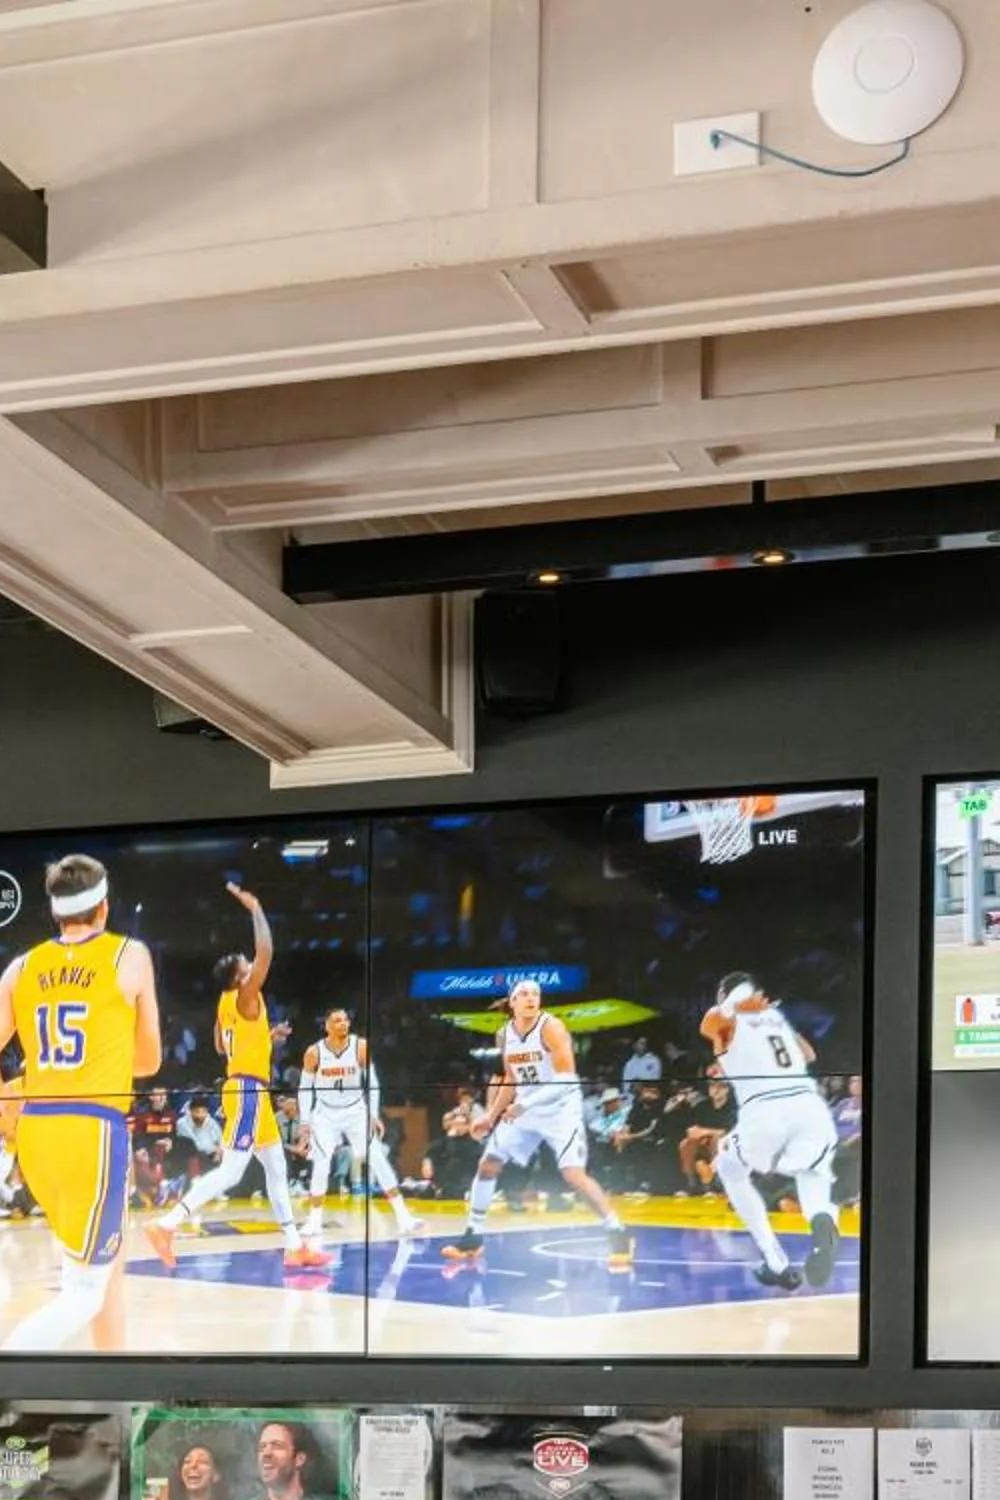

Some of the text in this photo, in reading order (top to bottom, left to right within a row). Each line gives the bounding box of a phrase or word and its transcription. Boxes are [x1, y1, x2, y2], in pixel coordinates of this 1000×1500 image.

[963, 799, 987, 811] TAB
[759, 829, 798, 846] LIVE
[35, 1003, 88, 1066] 15
[767, 1034, 793, 1069] 8
[538, 1455, 585, 1467] LIVE
